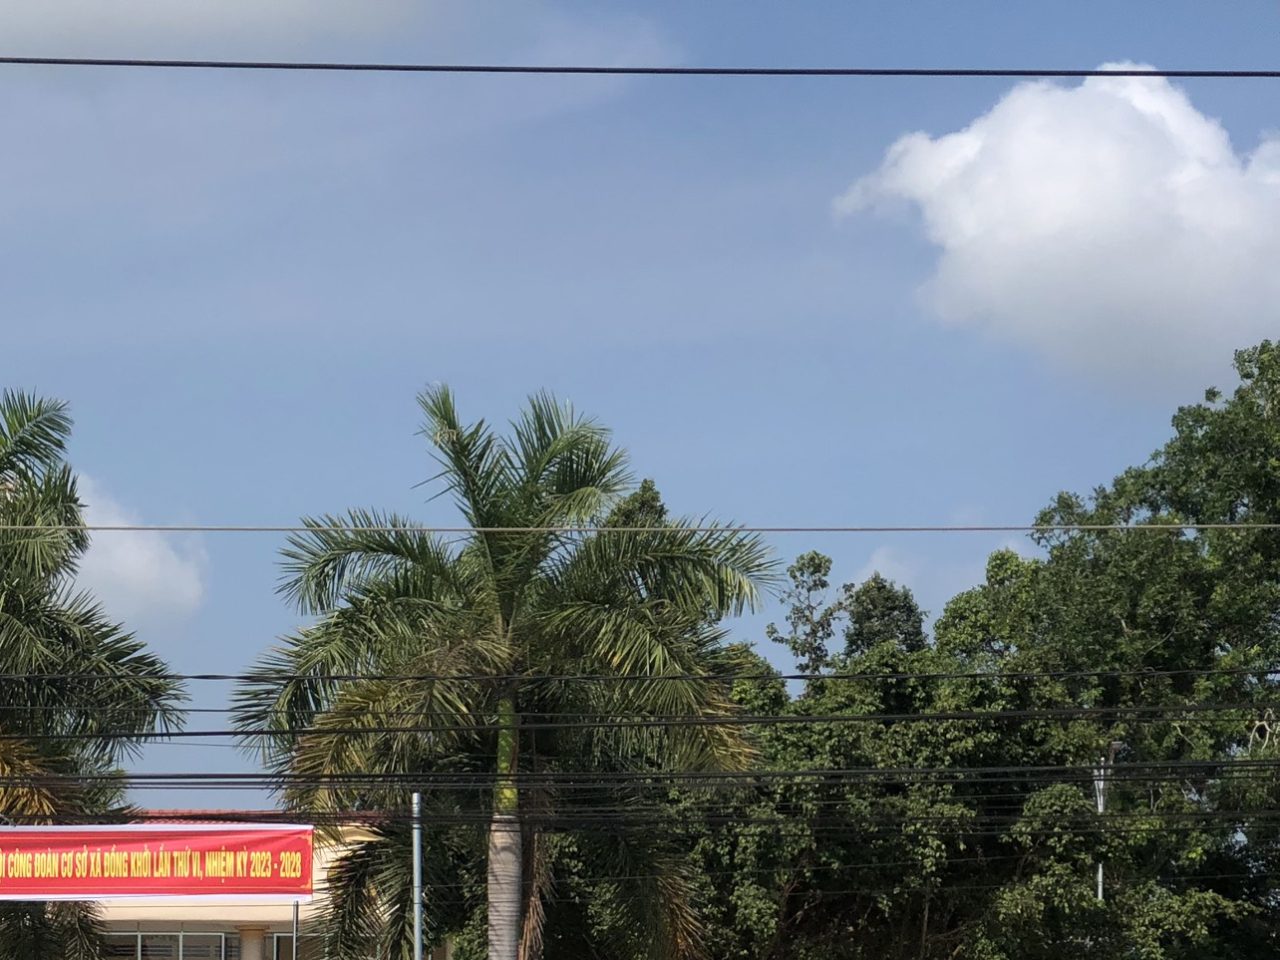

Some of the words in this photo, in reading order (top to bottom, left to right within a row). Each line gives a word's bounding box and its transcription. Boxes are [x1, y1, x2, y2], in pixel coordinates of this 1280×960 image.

[8, 847, 32, 878] CÔNG
[34, 847, 59, 878] ĐOÀN
[61, 849, 74, 878] CƠ
[75, 844, 88, 878] SỞ
[89, 848, 102, 878] XÃ
[104, 844, 128, 878] ĐỒNG
[130, 843, 151, 878] KHỞI
[173, 845, 191, 878] THỨ
[191, 851, 203, 880] VI,
[205, 845, 234, 883] NHIỆM
[236, 845, 248, 878] KỲ
[250, 851, 272, 878] 2023
[280, 851, 301, 878] 2028
